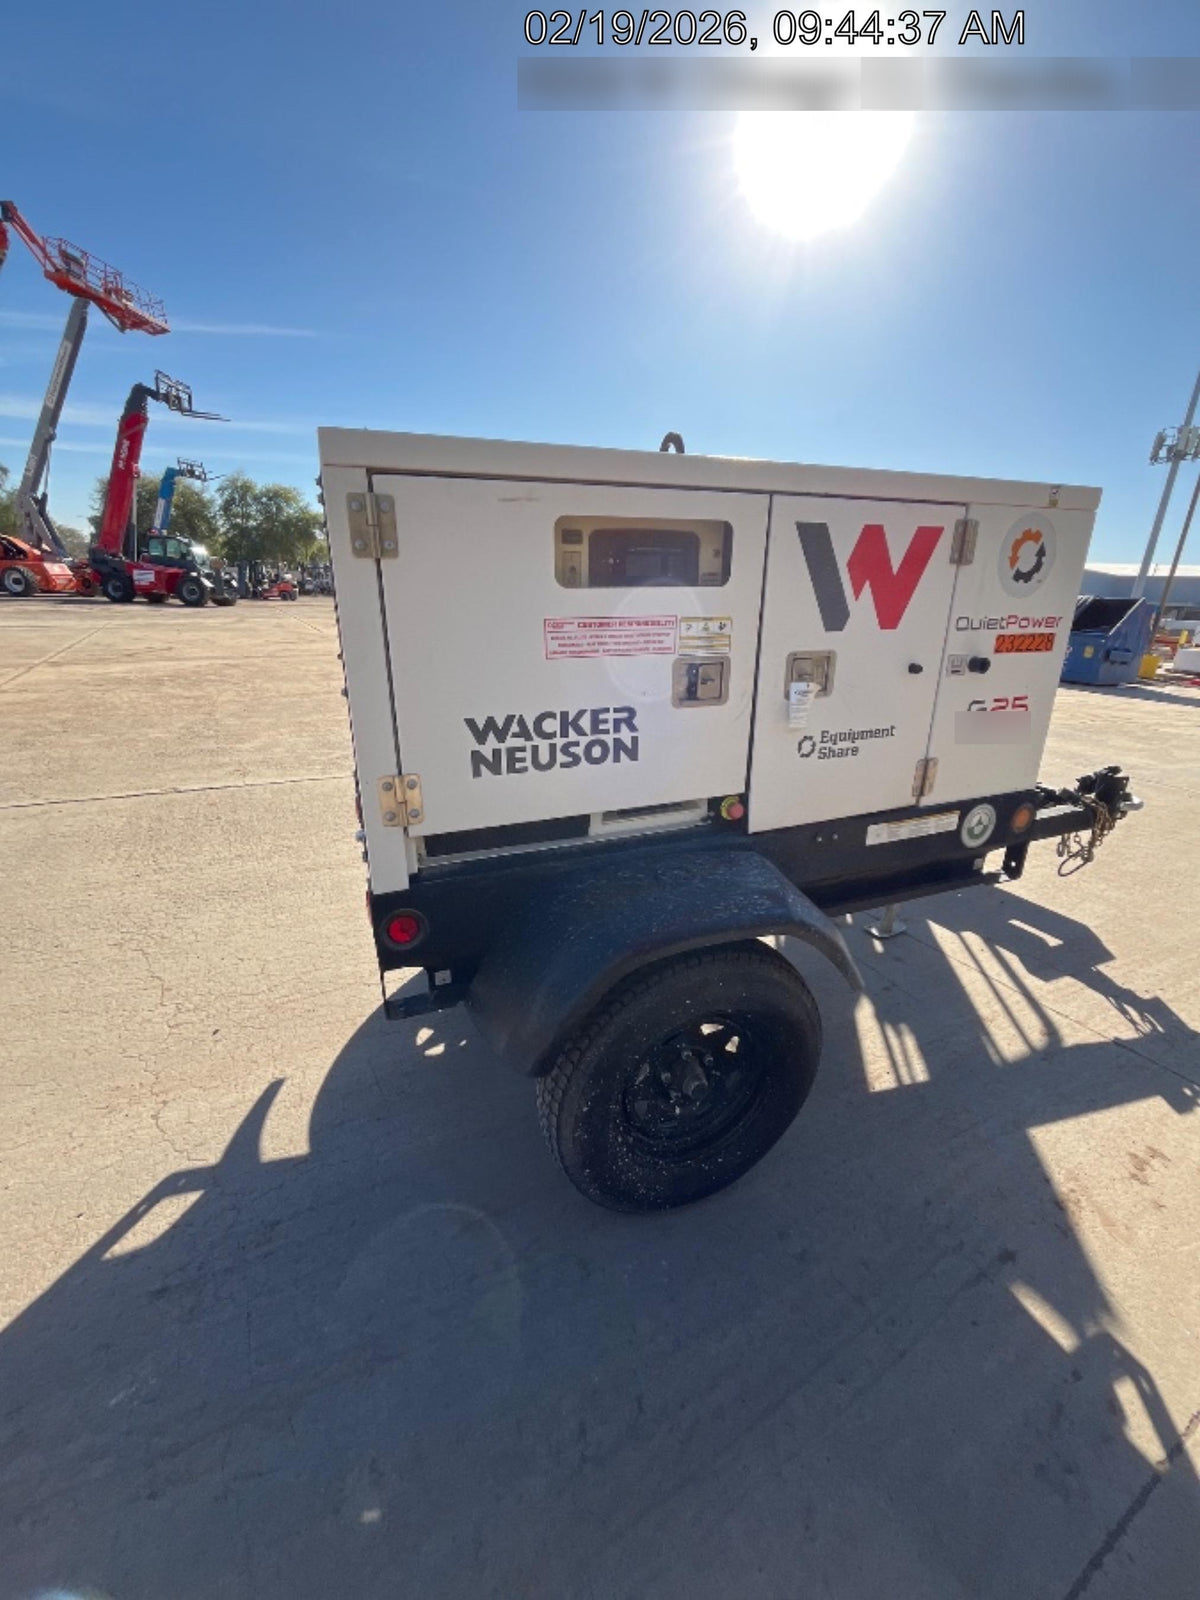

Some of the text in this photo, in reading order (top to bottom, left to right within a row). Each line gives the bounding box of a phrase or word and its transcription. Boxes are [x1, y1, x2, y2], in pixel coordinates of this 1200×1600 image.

[956, 614, 1064, 631] QuietPower
[463, 706, 639, 745] WACKER
[819, 725, 896, 745] Equipment
[470, 735, 640, 779] NEUSON
[817, 745, 860, 760] Share
